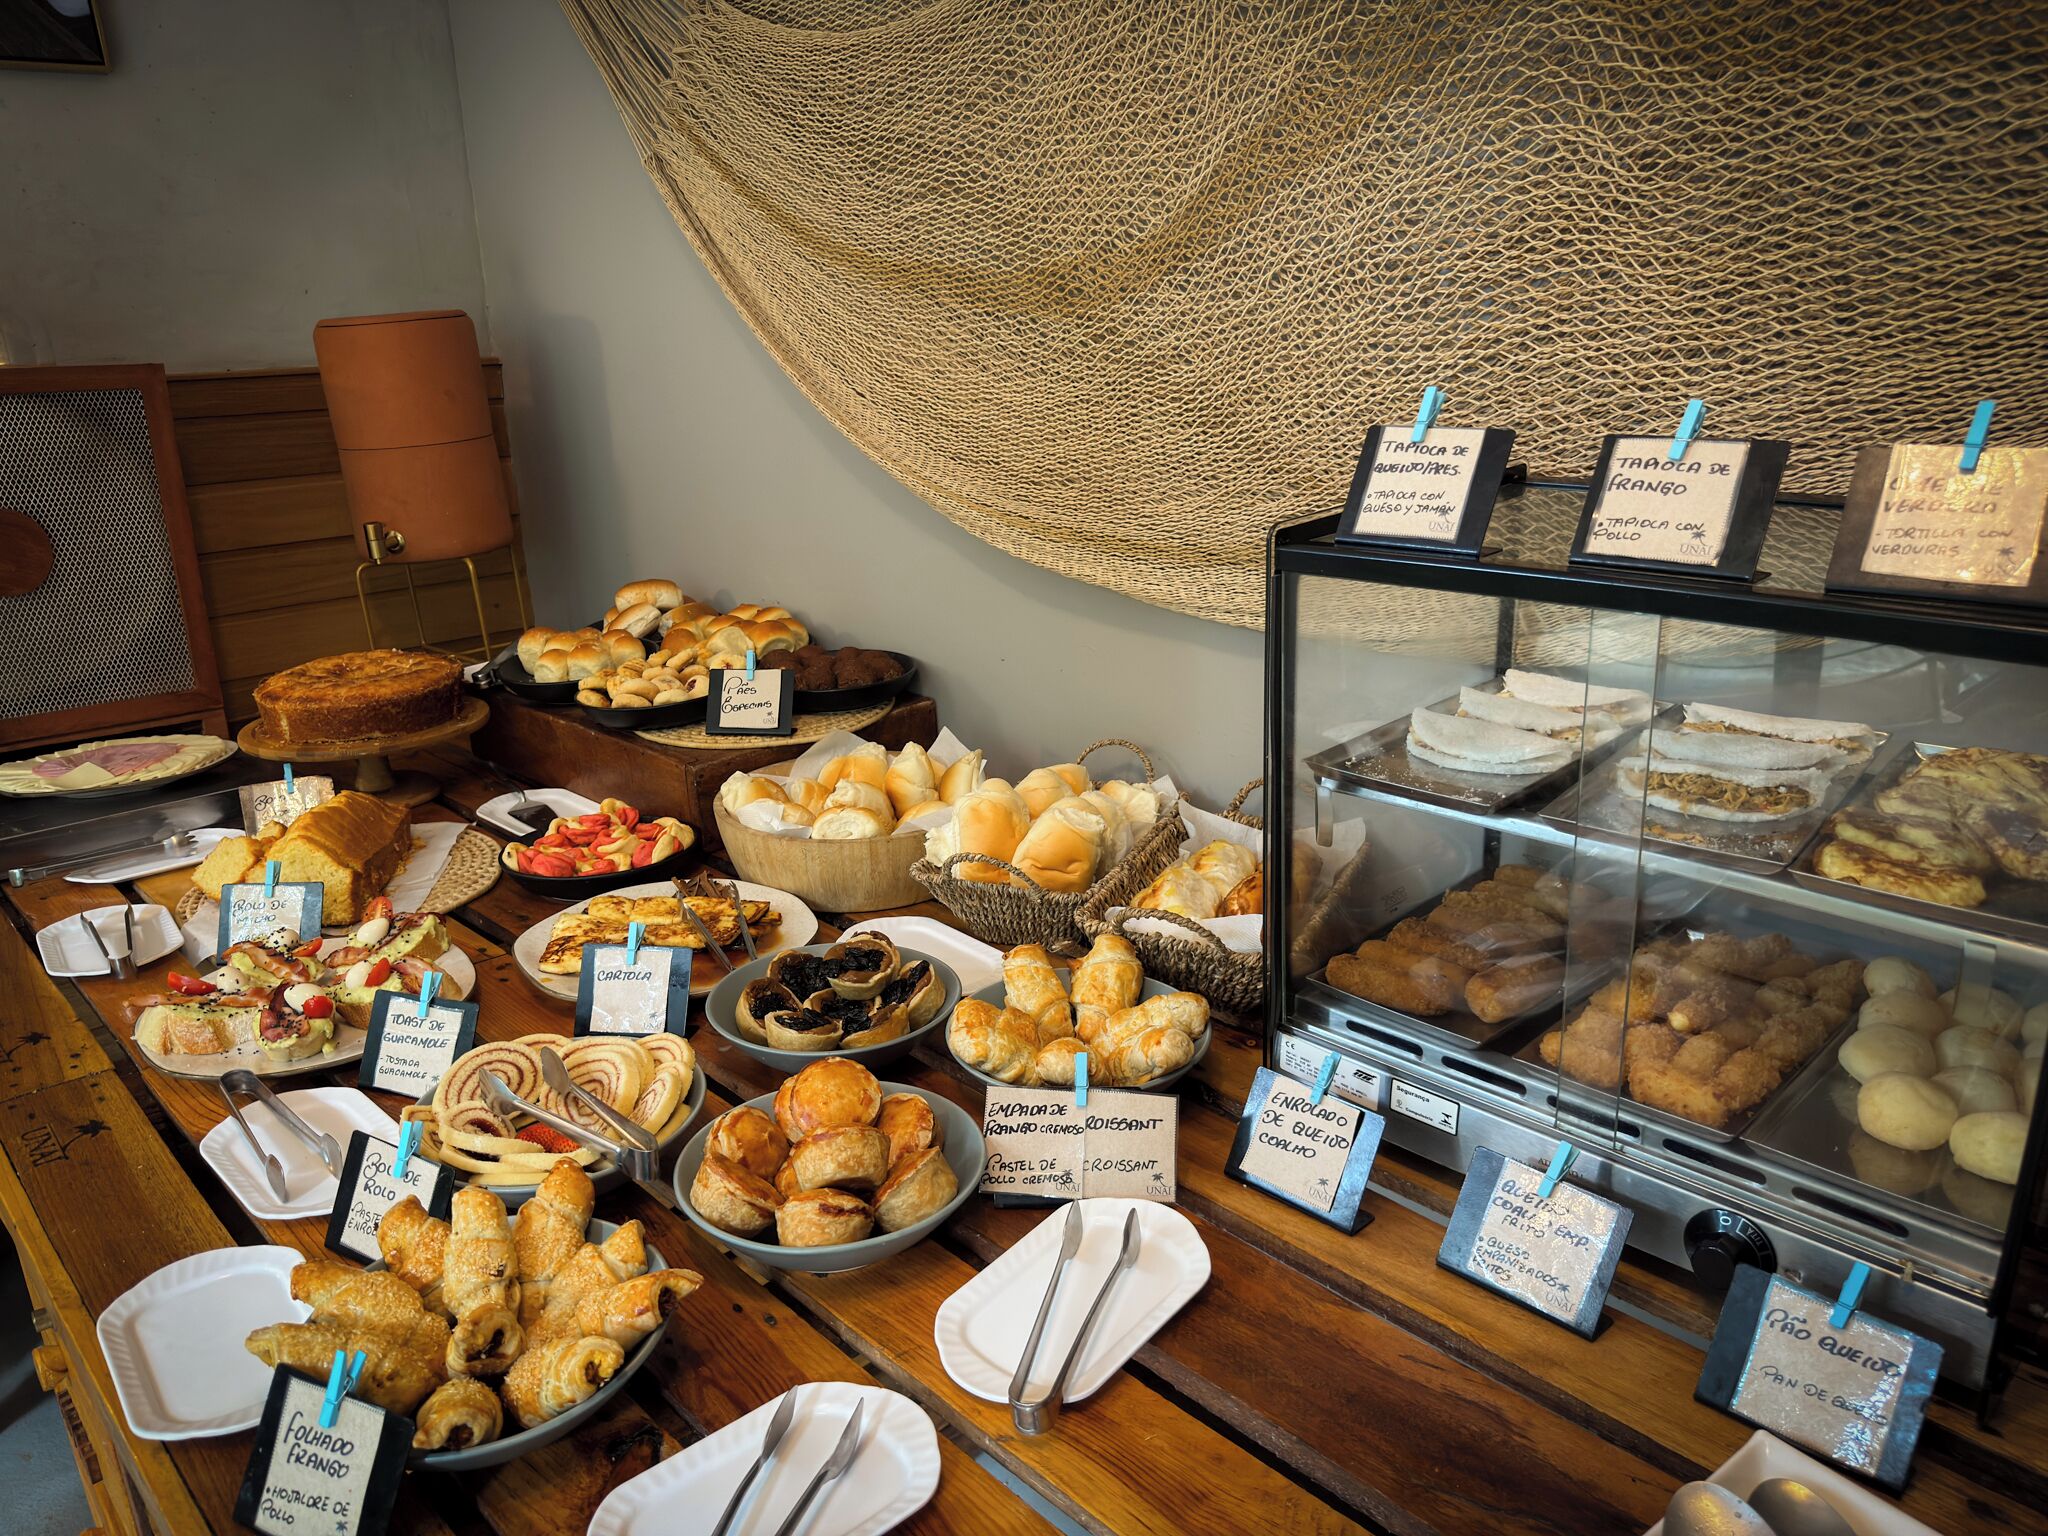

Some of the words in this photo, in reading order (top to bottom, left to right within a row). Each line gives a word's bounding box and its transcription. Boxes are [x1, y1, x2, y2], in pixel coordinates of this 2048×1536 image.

[1383, 440, 1447, 456] TAPIOCA
[1452, 445, 1469, 457] DE
[1616, 457, 1701, 474] TAPIOCA
[1708, 463, 1731, 476] DE
[1607, 473, 1688, 496] FRANGO
[1373, 489, 1416, 500] TAPIOCA
[1420, 491, 1445, 501] CON
[1363, 502, 1401, 513] QUESO
[1606, 517, 1669, 530] TAPIOCA
[1675, 522, 1704, 531] CON
[1593, 528, 1641, 541] POLLO
[1978, 529, 2014, 538] CON
[1871, 544, 1960, 556] VERDURAS
[597, 970, 652, 982] CARTOLA
[391, 1014, 426, 1028] TOAST
[383, 1032, 450, 1049] GUACAMOLE
[379, 1066, 427, 1079] GUACAMOLE
[1396, 1085, 1430, 1103] Segurança
[988, 1102, 1047, 1118] EMPADA
[1049, 1103, 1068, 1116] DE
[1271, 1091, 1348, 1127] ENROLADO
[1085, 1115, 1163, 1131] ROISSANT
[1262, 1110, 1284, 1128] DE
[984, 1119, 1038, 1138] FRANGO
[1040, 1124, 1085, 1135] CREMOSO
[1259, 1132, 1316, 1159] COALHO
[363, 1152, 394, 1180] BOL
[403, 1171, 422, 1187] DE
[984, 1153, 1034, 1171] PASTEL
[1040, 1158, 1056, 1170] DE
[1082, 1158, 1158, 1172] CROISSANT
[980, 1173, 1015, 1185] POLLO
[1022, 1171, 1073, 1184] CREMOSO
[363, 1178, 396, 1201] ROLO
[1501, 1214, 1545, 1238] FRITO
[1486, 1237, 1530, 1260] QUESO
[1765, 1308, 1811, 1341] PÃO
[1760, 1365, 1799, 1388] PAN
[1803, 1383, 1828, 1401] DE
[284, 1411, 355, 1456] FOLHADO
[287, 1442, 350, 1479] FRANGO
[271, 1485, 329, 1511] HOJALDRE
[333, 1501, 350, 1517] DE
[260, 1498, 295, 1525] POLLO
